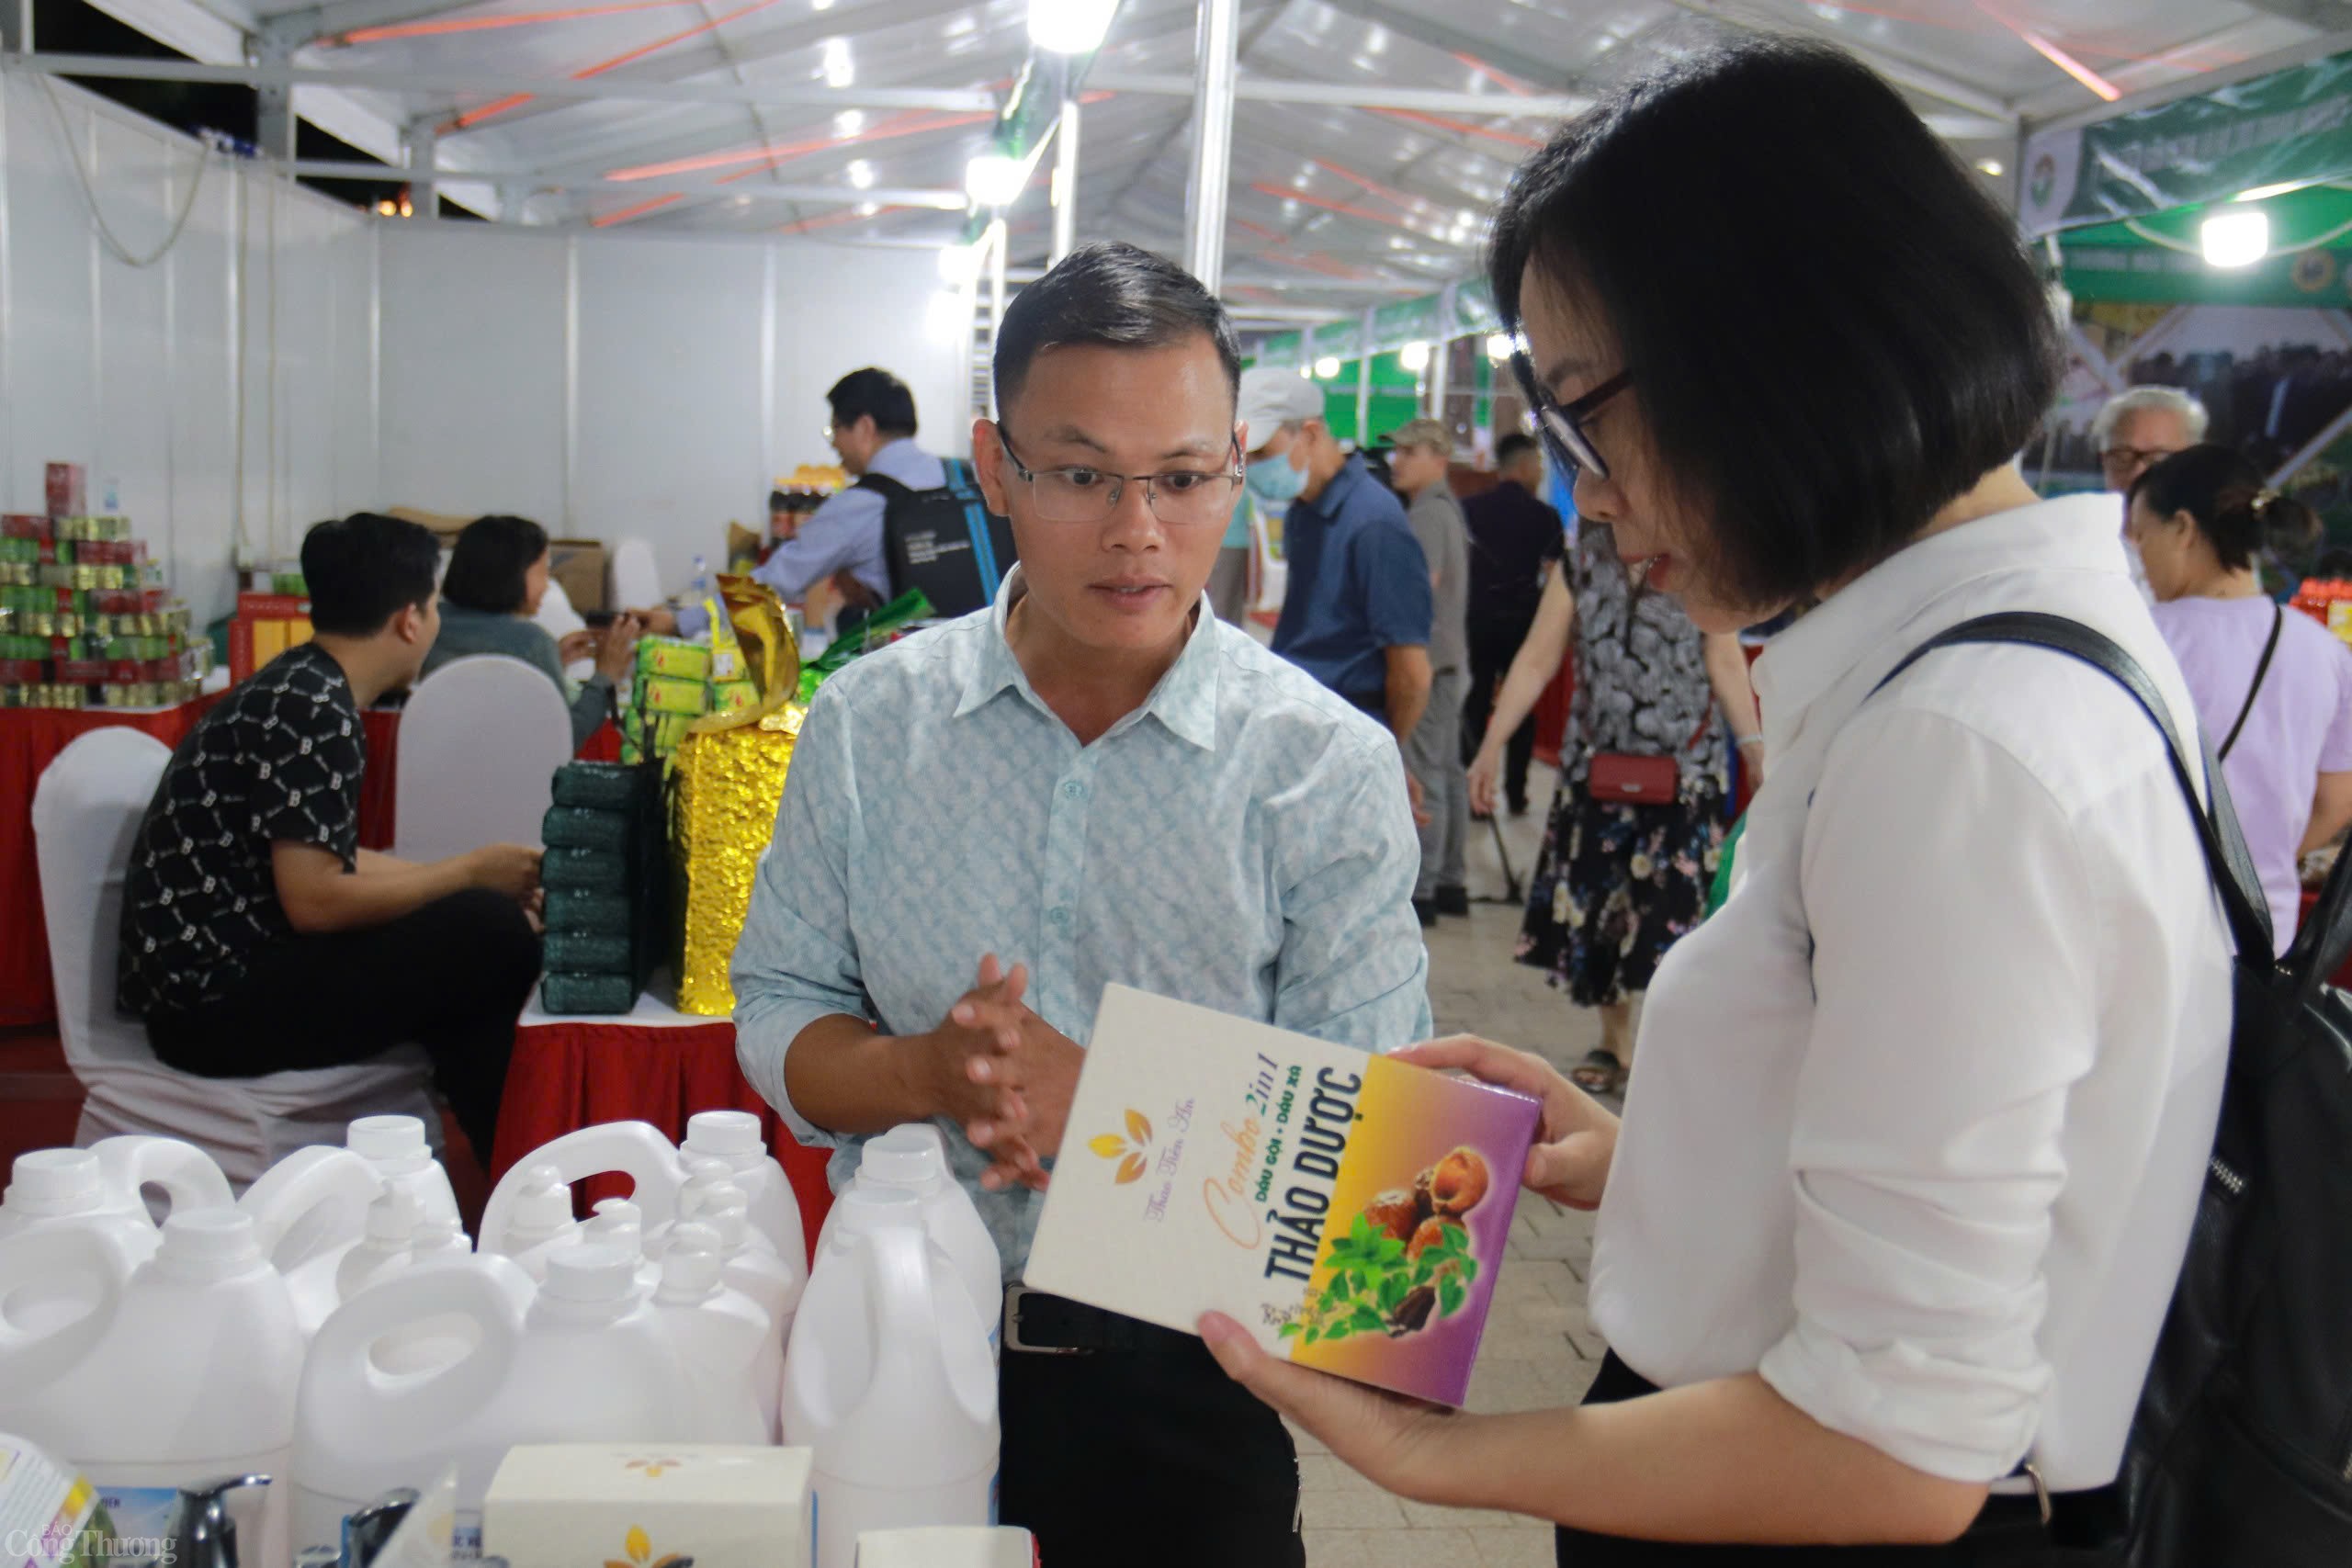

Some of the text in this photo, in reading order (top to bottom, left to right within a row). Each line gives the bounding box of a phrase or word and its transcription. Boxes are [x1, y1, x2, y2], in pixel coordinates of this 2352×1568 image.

[1264, 1137, 1283, 1166] GỘI
[1293, 1066, 1363, 1182] DƯỢC
[1204, 1117, 1261, 1249] Combo
[1263, 1186, 1330, 1282] THẢO
